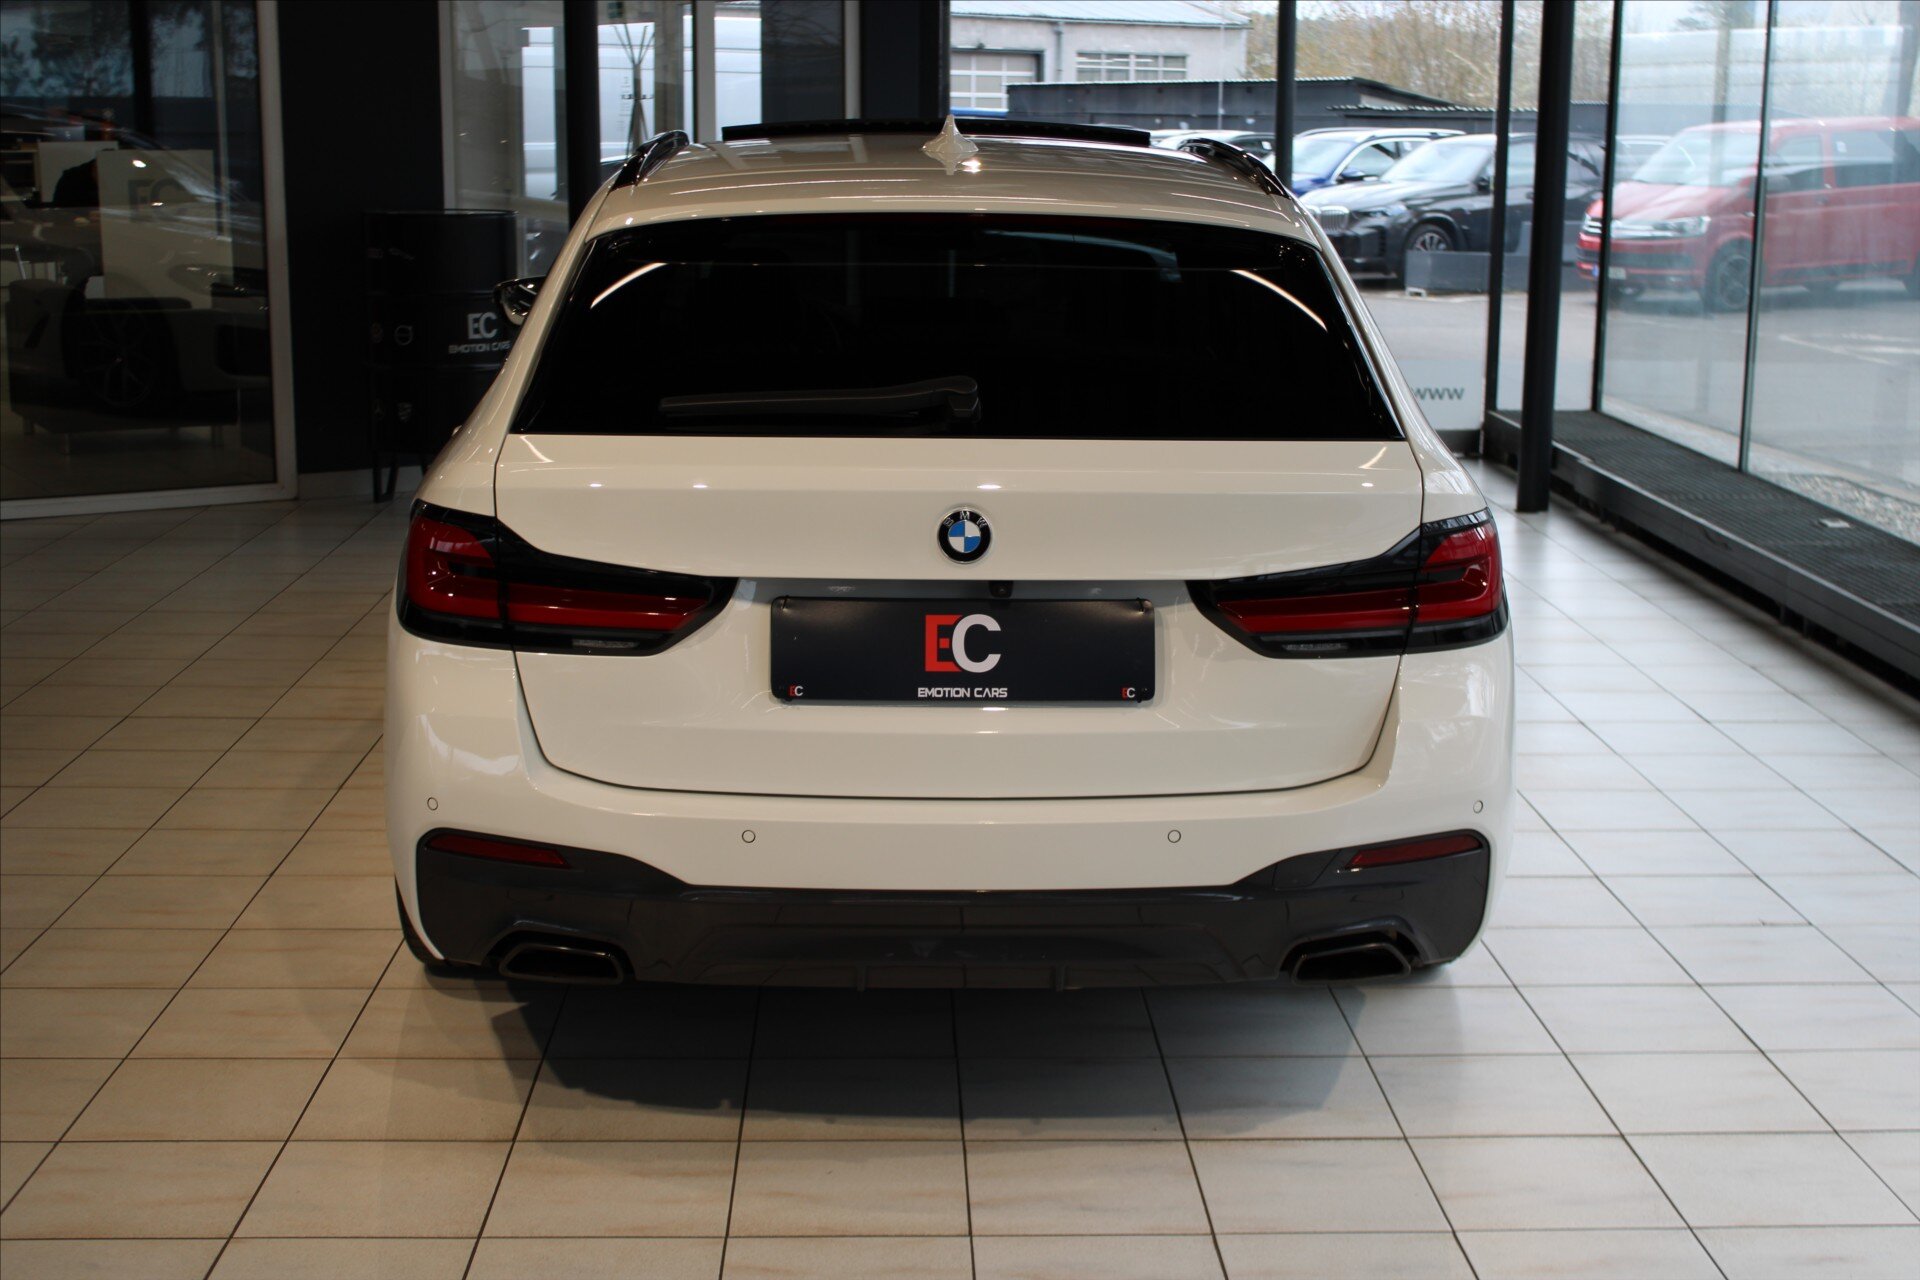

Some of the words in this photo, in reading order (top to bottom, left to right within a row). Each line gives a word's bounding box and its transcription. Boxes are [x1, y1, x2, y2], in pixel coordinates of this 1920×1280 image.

[467, 311, 498, 339] EC
[448, 343, 490, 354] EMOTION
[943, 510, 988, 528] BMW
[924, 613, 1002, 674] EC
[789, 685, 804, 697] EC
[917, 687, 971, 698] EMOTION
[973, 687, 1008, 698] CARS
[1122, 687, 1136, 699] EC
